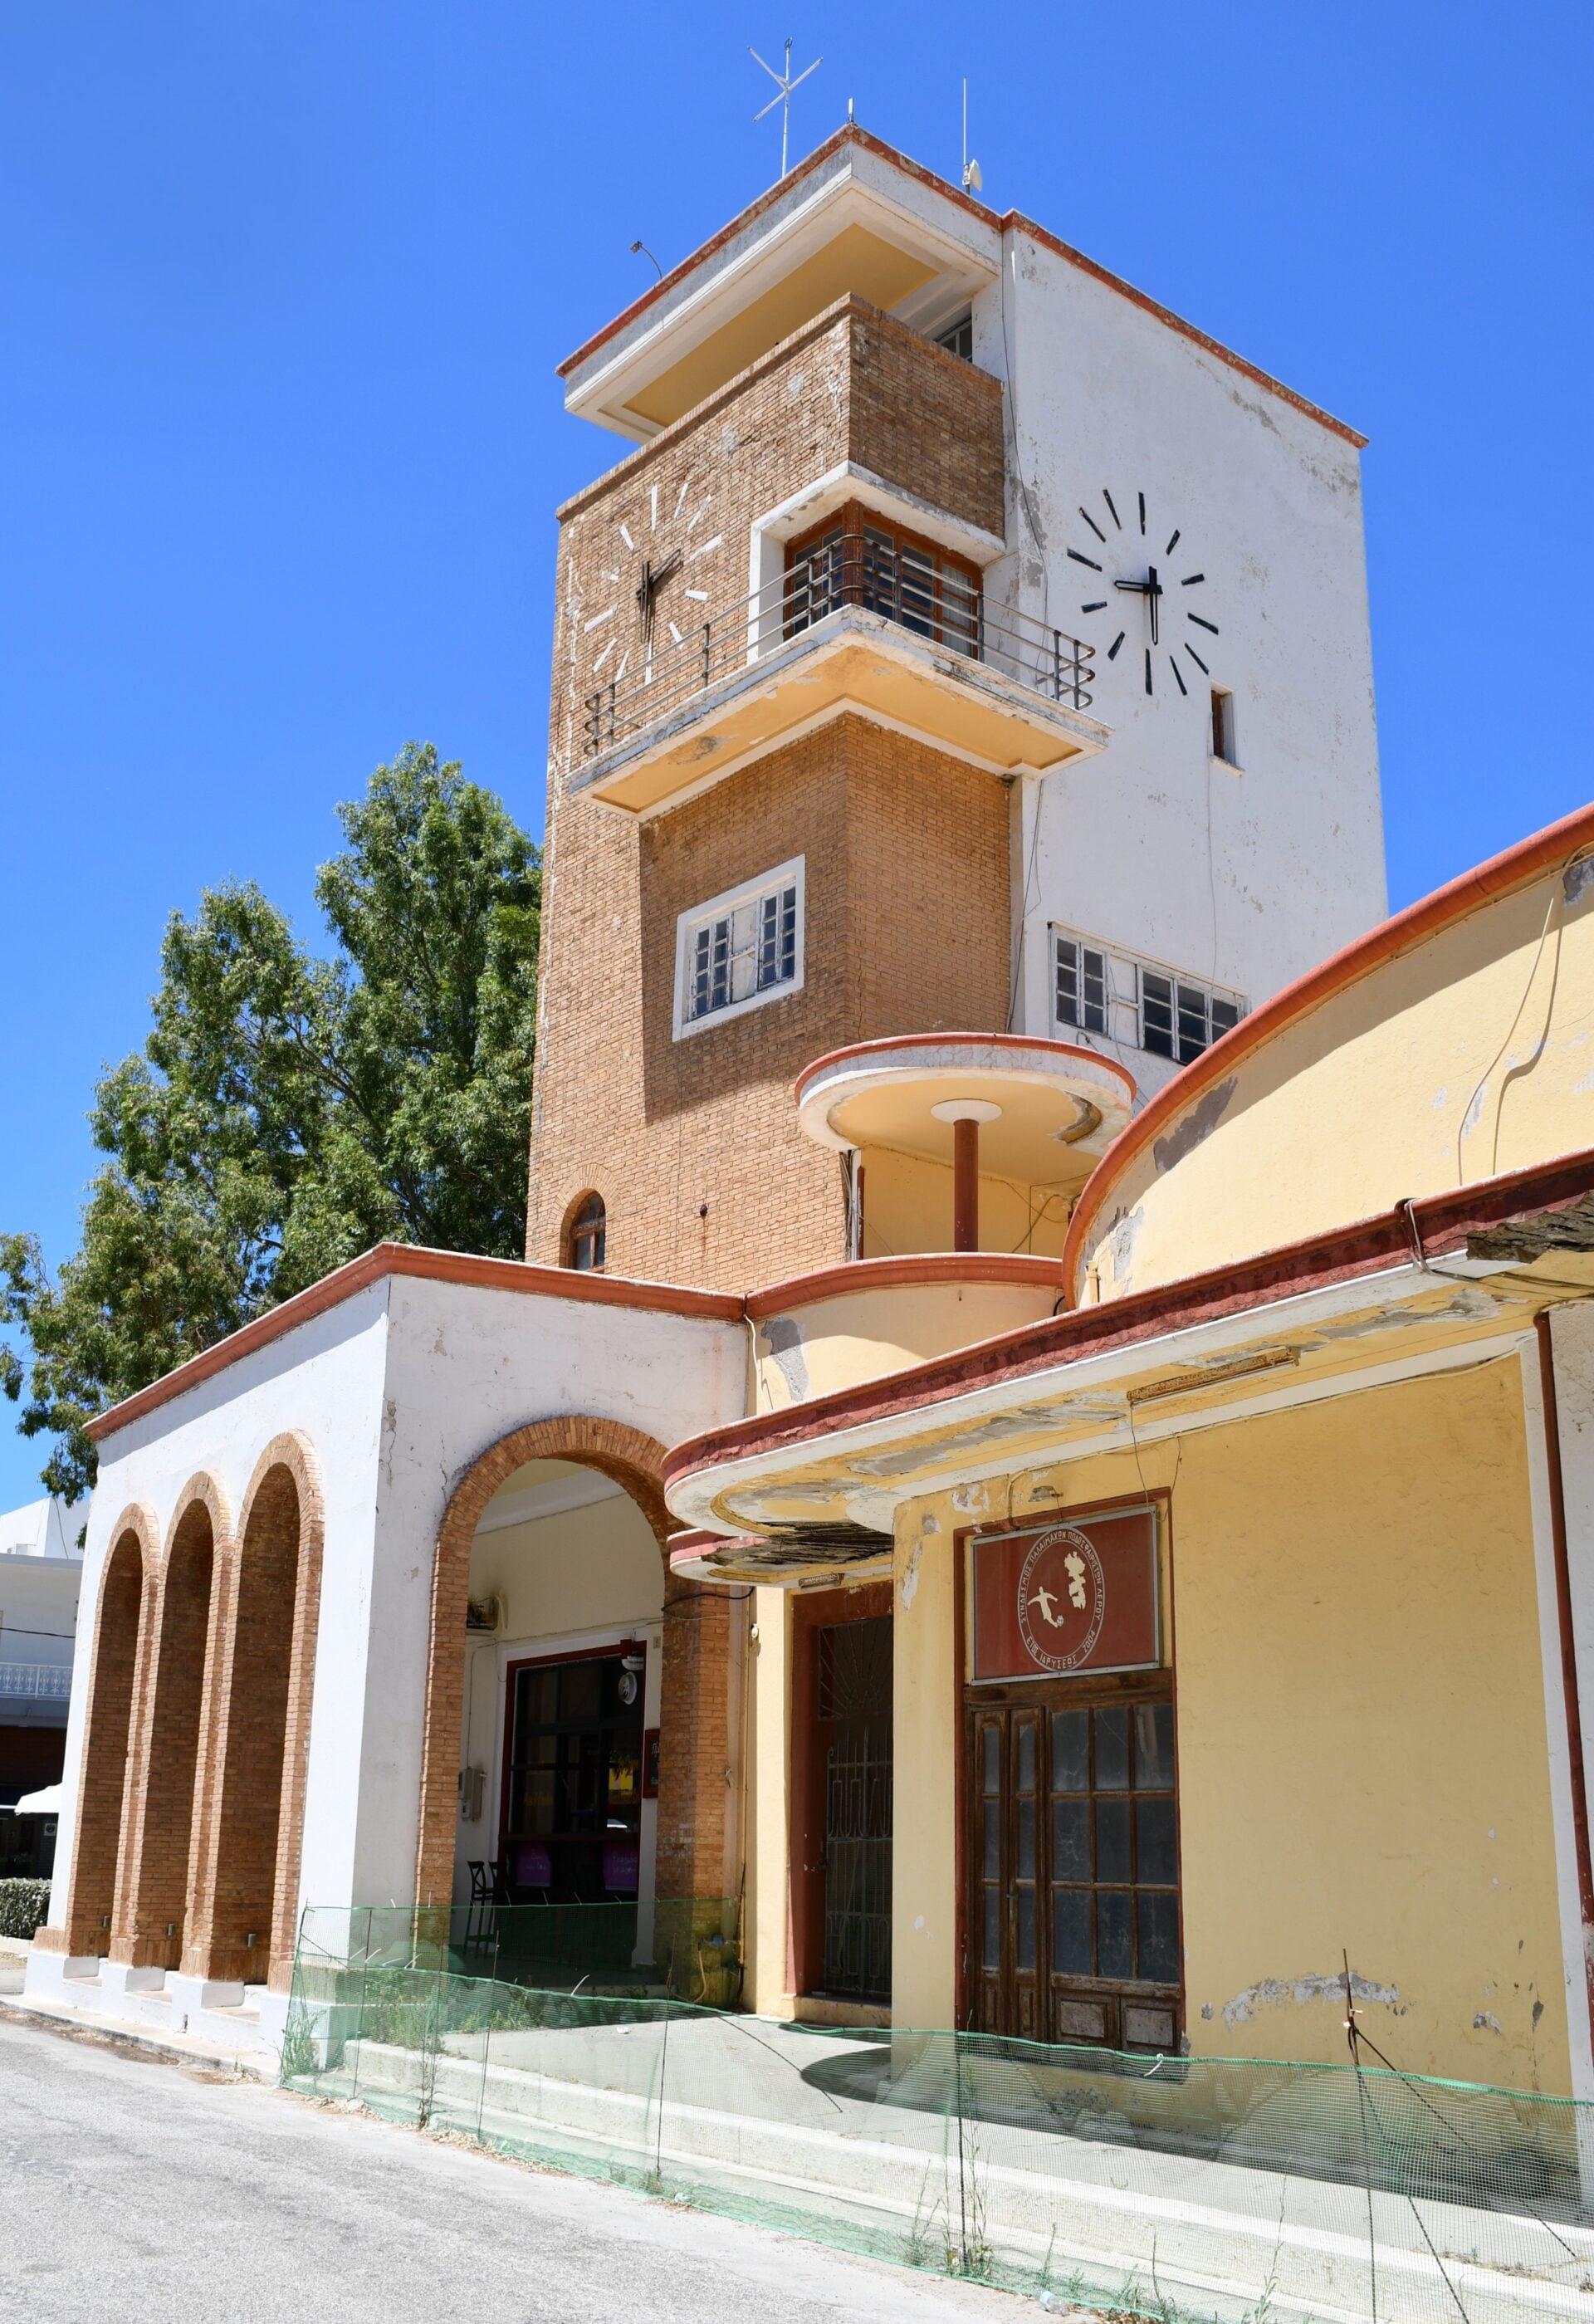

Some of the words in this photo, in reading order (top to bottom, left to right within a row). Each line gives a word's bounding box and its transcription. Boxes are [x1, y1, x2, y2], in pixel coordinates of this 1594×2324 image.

[1019, 1565, 1031, 1624] ΣΥΝΔΕΣΜΟΣ
[1029, 1530, 1067, 1563] ΠΑΛΑΙΜΑΧΩΝ
[1067, 1532, 1103, 1584] ΠΟΔΟΣΦΑΙΡΙΣΤΩΝ
[1095, 1588, 1103, 1622] ΛΕΡΟΥ
[1026, 1636, 1039, 1656] ΕΤΟΣ
[1039, 1654, 1077, 1669] ΙΔΡΥΣΕΩΣ
[1083, 1629, 1096, 1653] 2004
